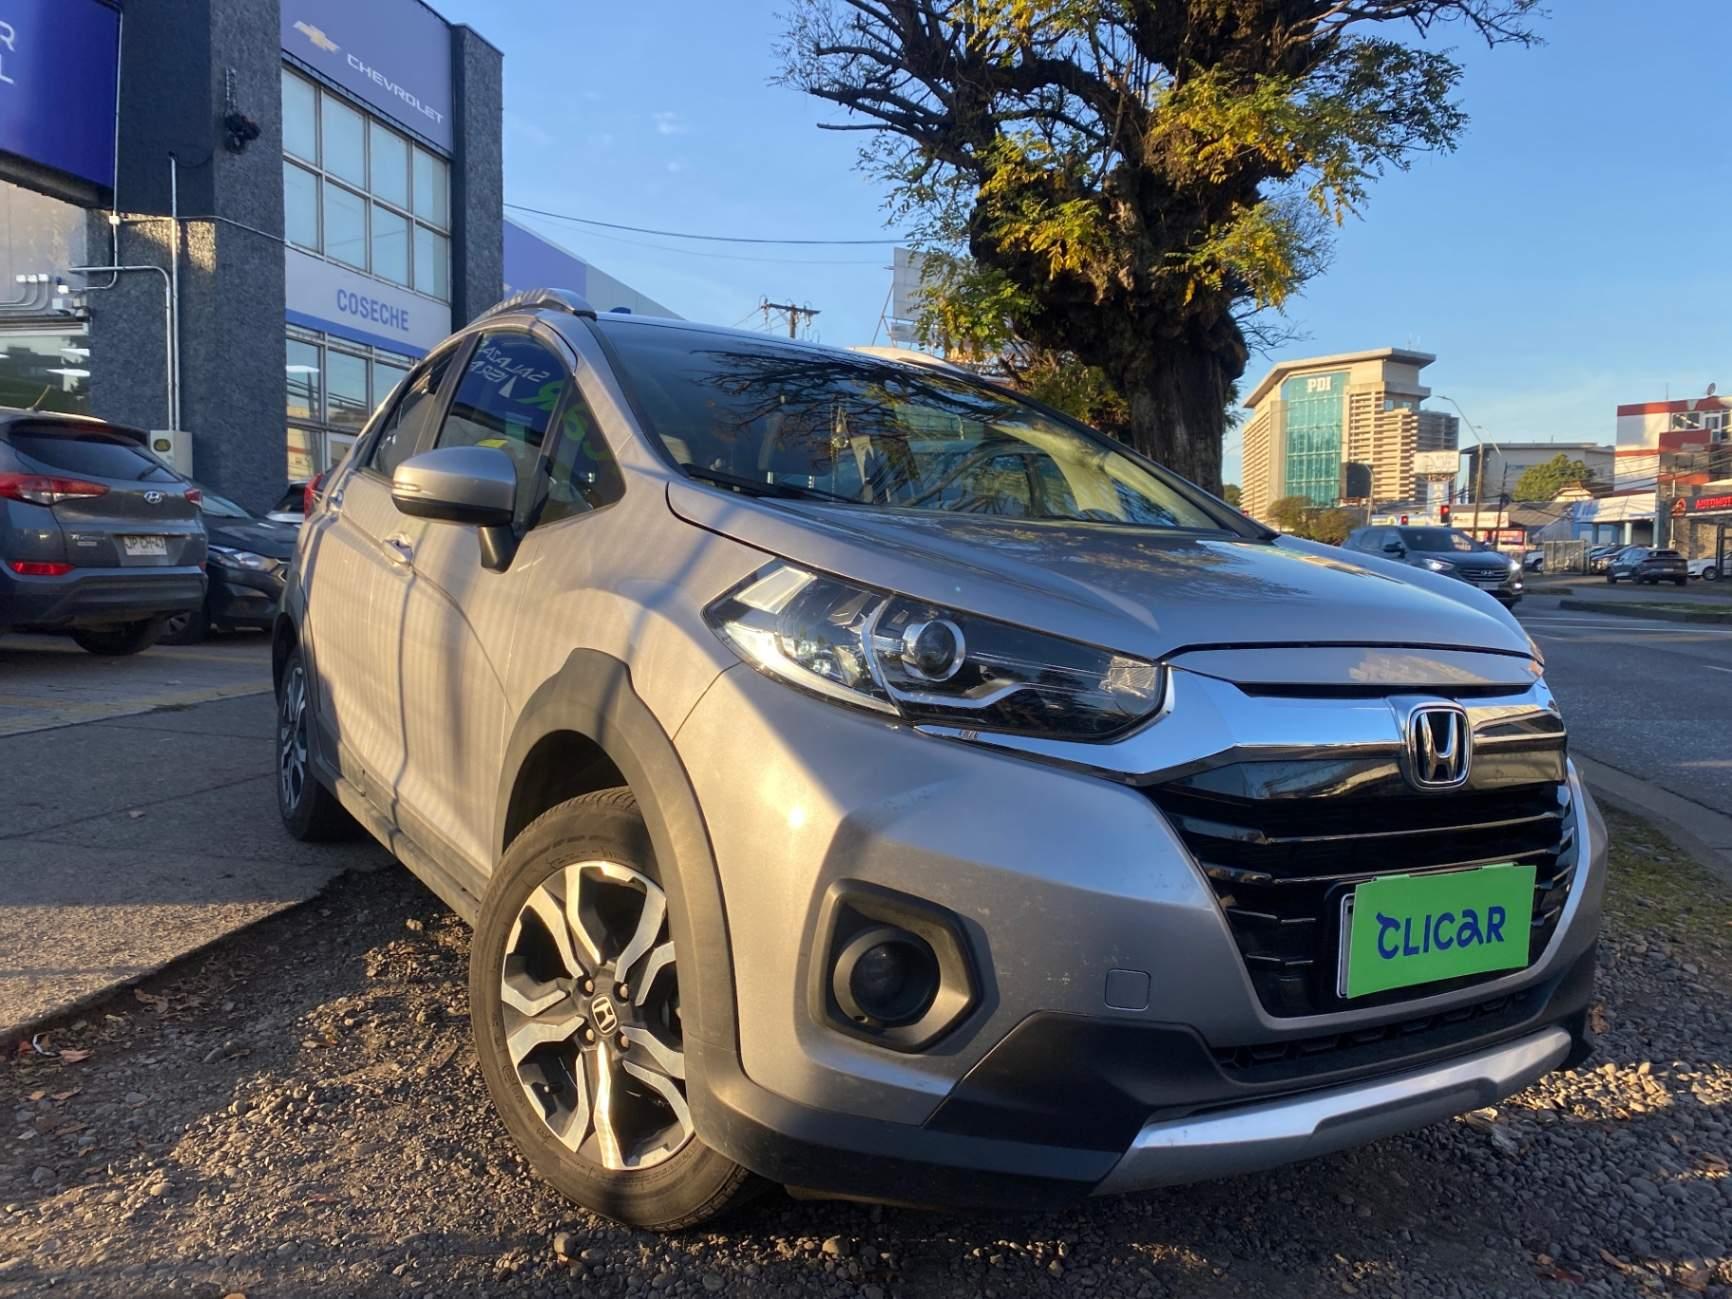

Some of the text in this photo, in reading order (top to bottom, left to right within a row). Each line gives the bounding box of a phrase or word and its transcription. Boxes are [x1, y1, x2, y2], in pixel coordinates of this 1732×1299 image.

[347, 53, 444, 124] CHEVROLET
[336, 288, 409, 332] COSECHE
[1307, 375, 1332, 393] PDI
